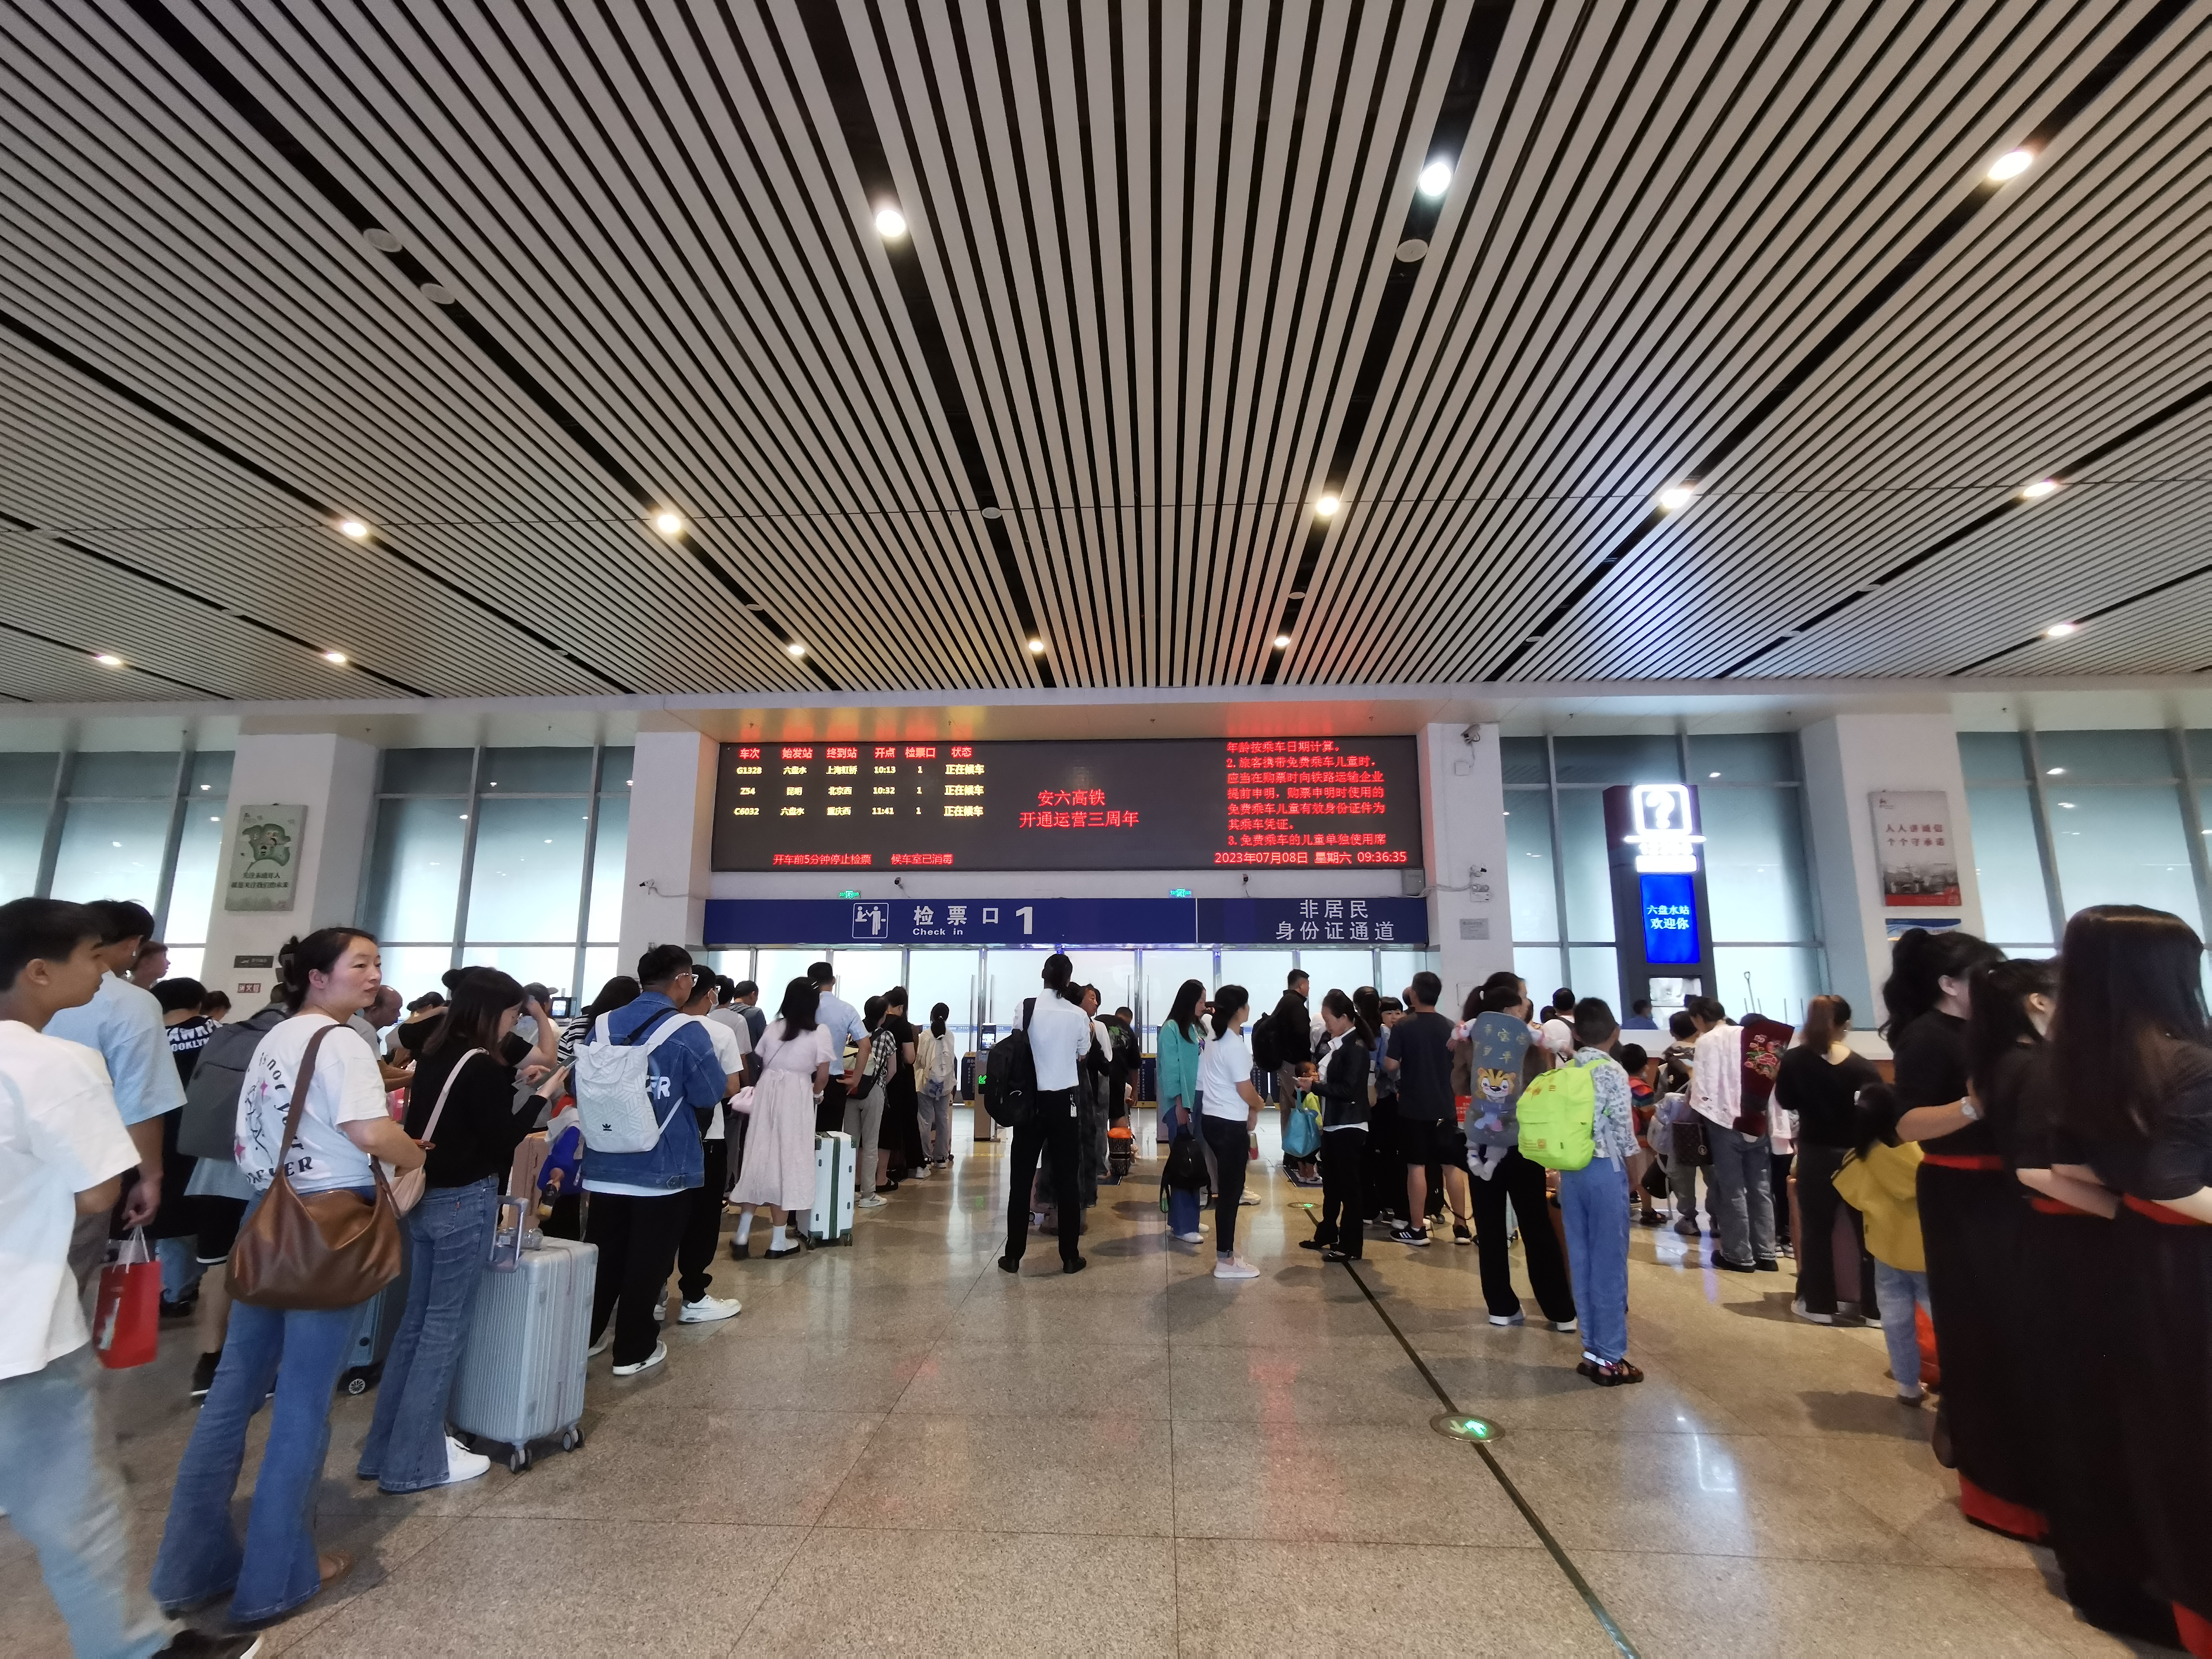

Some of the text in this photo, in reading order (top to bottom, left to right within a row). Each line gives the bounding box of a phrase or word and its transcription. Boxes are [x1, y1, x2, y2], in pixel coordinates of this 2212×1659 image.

[739, 747, 973, 760] 车次 始发站 终到站 开点 检票口 状态
[1227, 741, 1339, 753] 年龄按乘车日期计算。
[736, 766, 762, 775] G1328
[783, 766, 807, 775] 六盘水
[826, 766, 858, 775] 上海虹桥
[945, 764, 985, 775] 正在候车
[1227, 771, 1384, 784] 应当在购票时向铁路运输企业
[786, 787, 803, 796] 昆明
[828, 786, 853, 795] 北京西
[944, 785, 984, 795] 正在候车
[1038, 789, 1105, 806] 安六高铁
[780, 807, 805, 816] 六盘水
[826, 807, 852, 816] 重庆西
[943, 805, 984, 817] 正在候车
[1228, 802, 1385, 815] 免费乘车儿童有效身份证件为
[1020, 810, 1139, 828] 开通运营三周年
[1228, 818, 1294, 830] 其乘车凭证。
[773, 854, 953, 865] 开车前5分钟停止检票 候车室已消毒
[1214, 851, 1407, 864] 2023年07月08日 星期六 09:36:35
[1300, 899, 1368, 918] 非居民
[1646, 905, 1690, 915] 六盘水站
[913, 906, 1033, 934] 检票口 1
[1650, 917, 1690, 930] 欢迎你
[1276, 921, 1394, 941] 身份证通道
